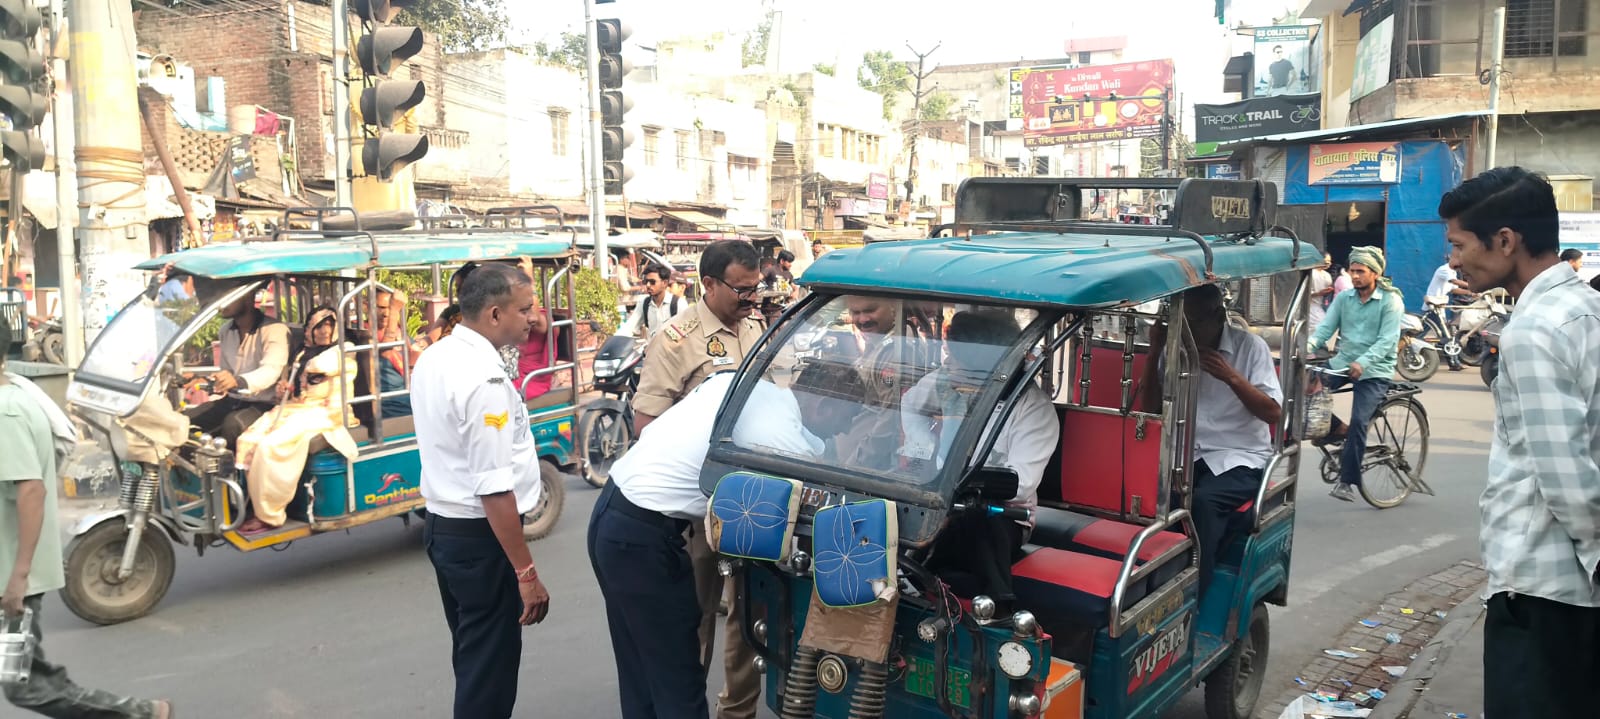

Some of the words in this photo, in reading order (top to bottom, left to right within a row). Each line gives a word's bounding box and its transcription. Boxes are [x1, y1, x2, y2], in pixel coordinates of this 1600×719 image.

[1266, 27, 1308, 36] COLLECTION
[1077, 71, 1101, 81] Diwali
[1063, 81, 1099, 93] Kundan
[1101, 79, 1121, 90] Wali
[1313, 151, 1350, 166] यातायात
[1352, 148, 1379, 165] पुलिस
[1134, 620, 1187, 679] VIJETA
